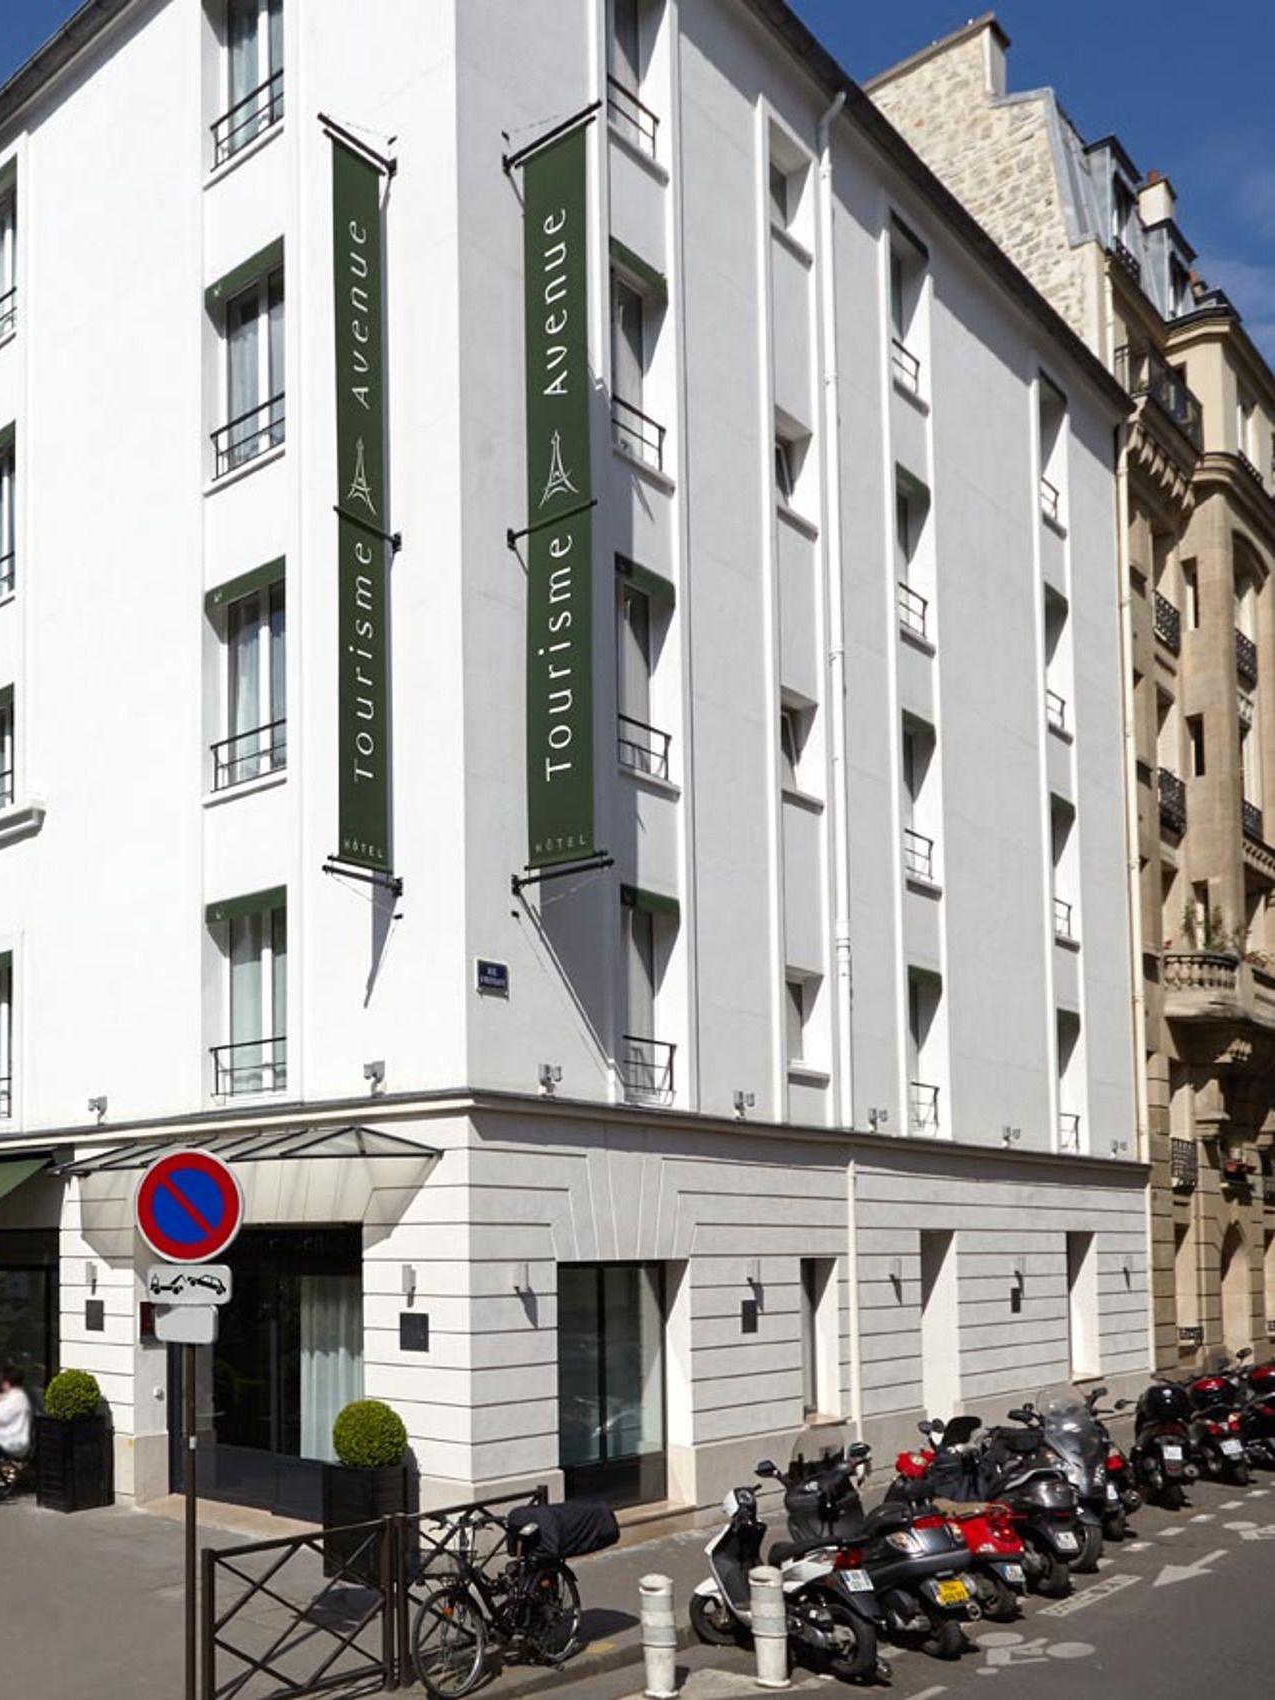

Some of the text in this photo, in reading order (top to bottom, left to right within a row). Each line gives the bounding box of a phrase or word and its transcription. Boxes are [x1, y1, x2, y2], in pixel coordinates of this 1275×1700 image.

[347, 220, 370, 410] Avenue
[543, 206, 569, 396] Avenue
[347, 541, 376, 783] Tourisme
[537, 533, 573, 783] Tourisme
[535, 834, 586, 854] HÔTEL
